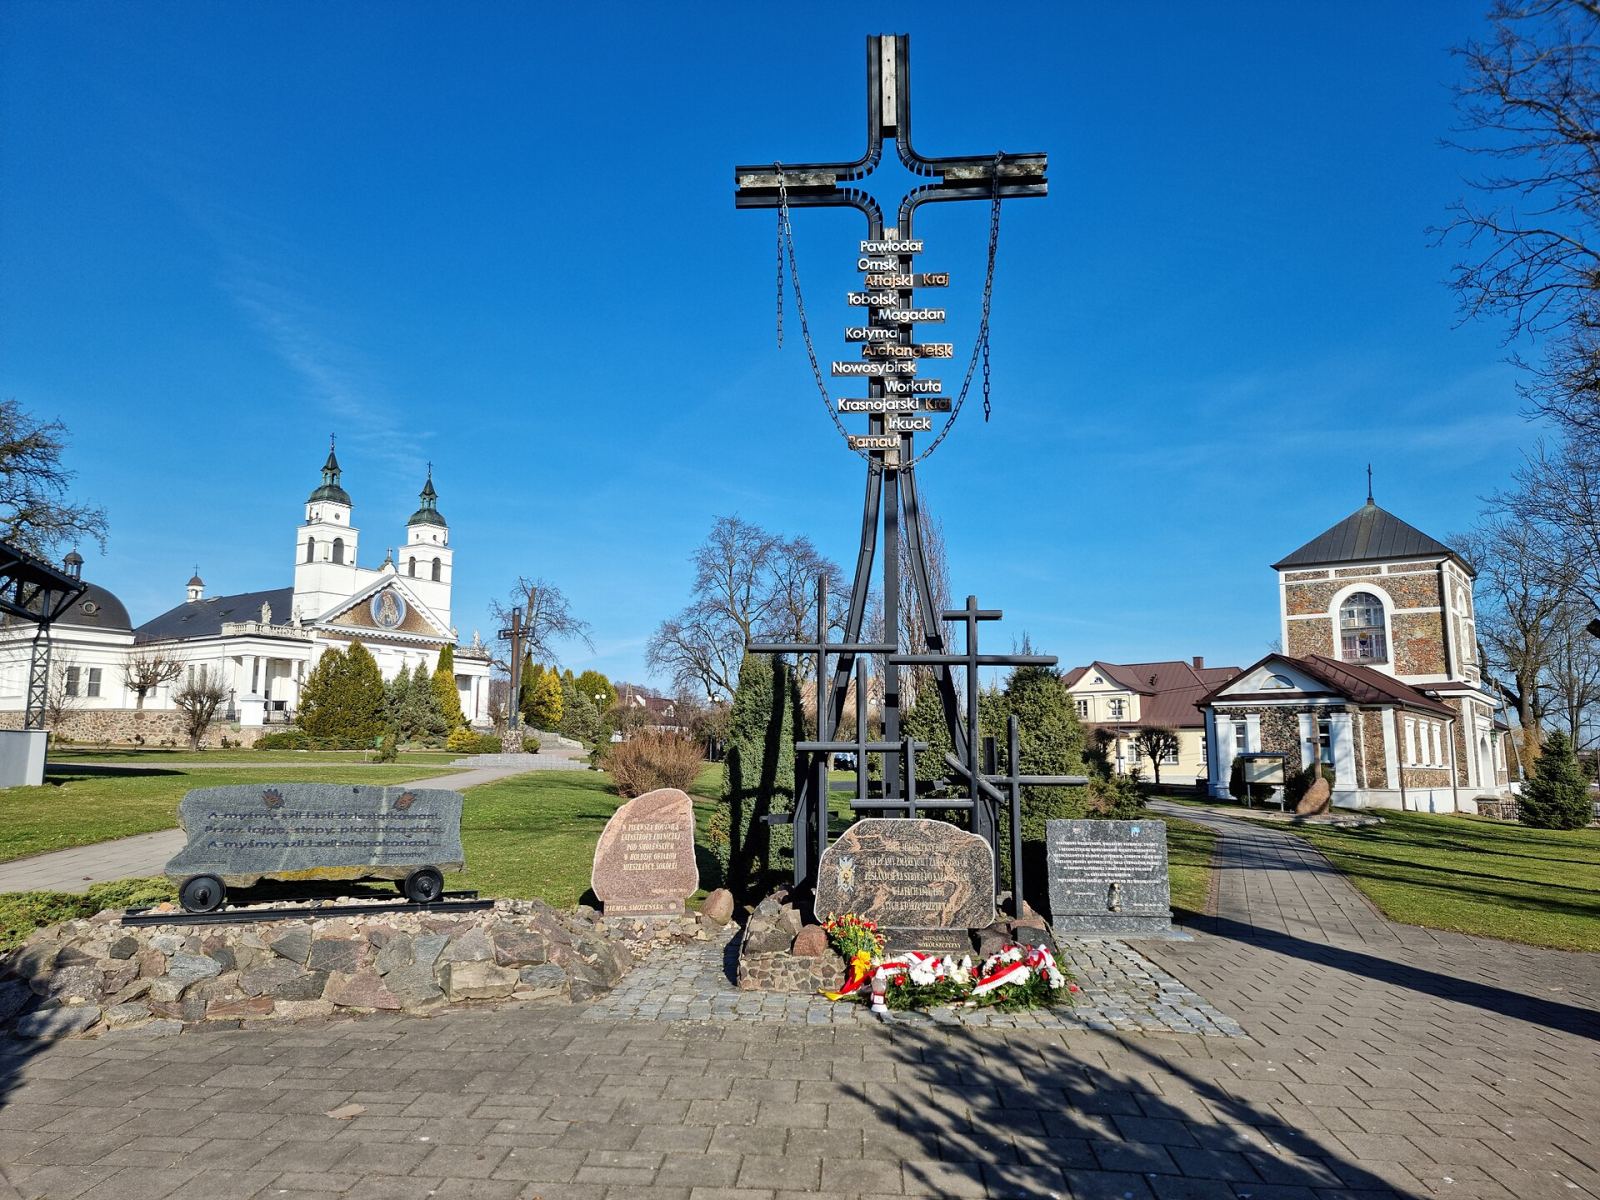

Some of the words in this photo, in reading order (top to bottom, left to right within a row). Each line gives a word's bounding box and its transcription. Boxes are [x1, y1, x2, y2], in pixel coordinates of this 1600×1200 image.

[860, 240, 923, 252] Pawłodar
[858, 258, 897, 271] Omsk
[865, 274, 914, 288] Ałtajski
[923, 273, 950, 286] Kraj
[848, 292, 897, 305] Tobolsk
[879, 308, 945, 322] Magadan
[845, 327, 898, 340] Kołyma
[863, 343, 953, 358] Archangielsk
[832, 361, 916, 375] Nowosybirsk
[885, 380, 941, 393] Workuta
[838, 397, 919, 412] Krasnojarski
[889, 417, 931, 430] Irkuck
